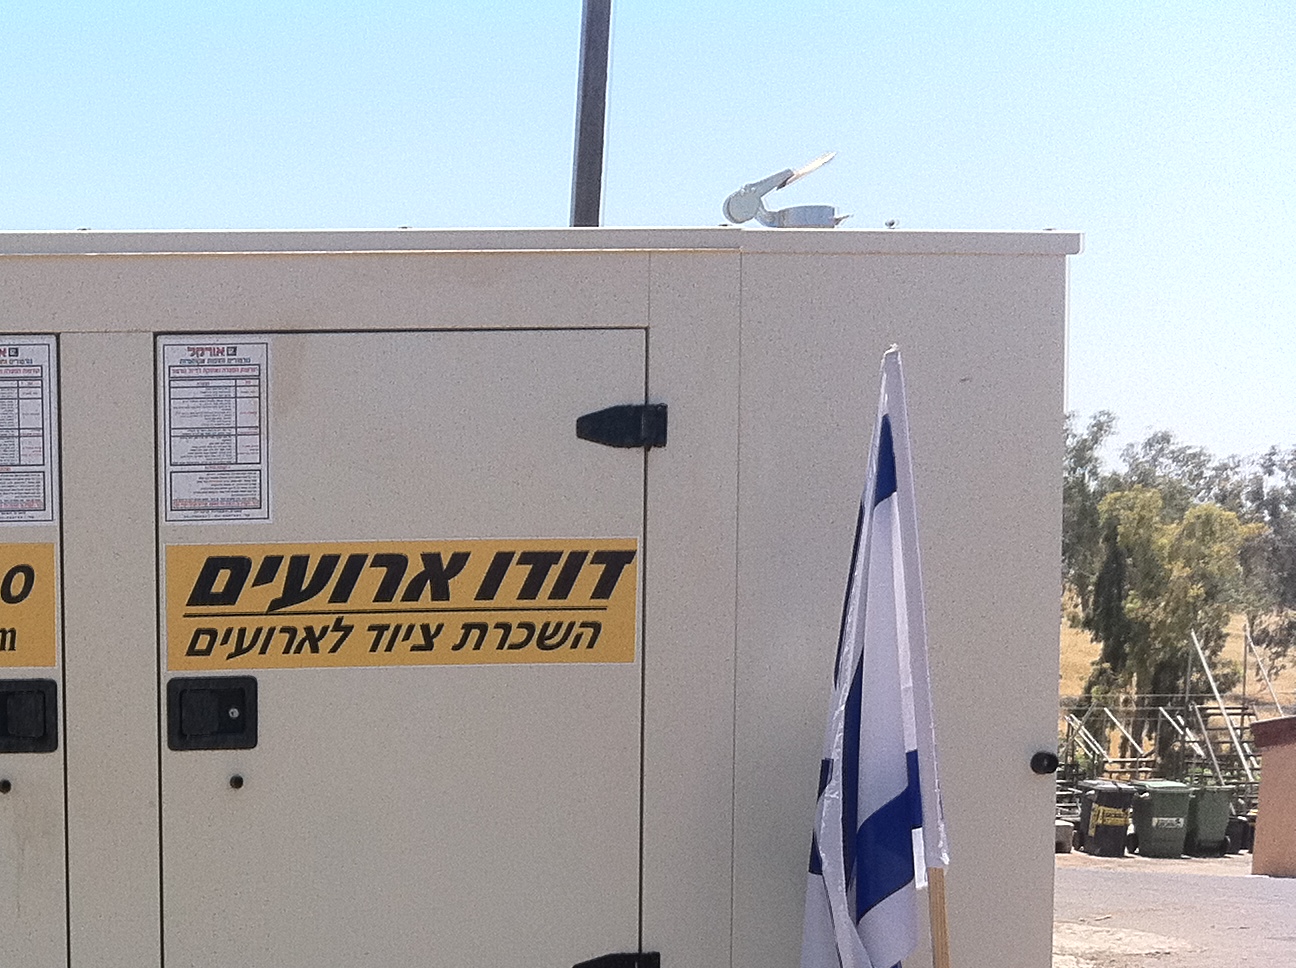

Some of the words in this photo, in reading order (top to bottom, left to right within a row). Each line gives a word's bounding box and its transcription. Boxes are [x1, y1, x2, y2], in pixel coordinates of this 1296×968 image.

[186, 551, 472, 613] ארועים
[474, 549, 637, 601] דודו
[186, 615, 355, 660] לארועים
[366, 622, 444, 653] ציוד
[451, 620, 602, 652] השכרת
